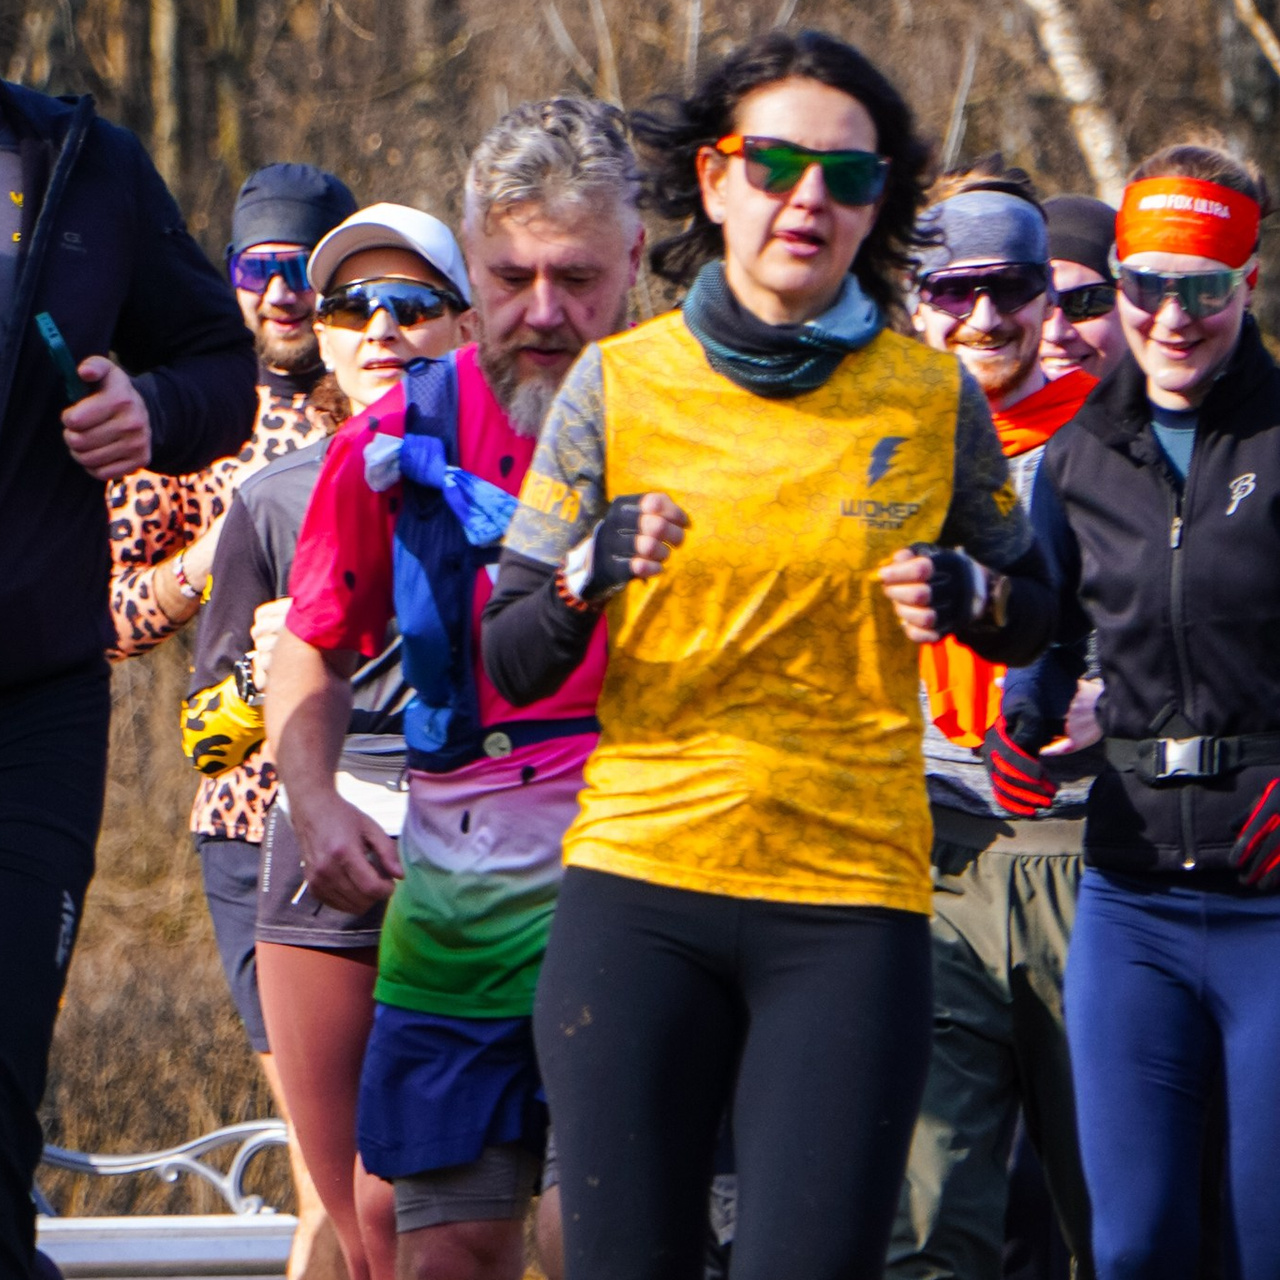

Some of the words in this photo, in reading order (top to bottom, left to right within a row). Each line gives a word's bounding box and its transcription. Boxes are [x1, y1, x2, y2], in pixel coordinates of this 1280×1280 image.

[1167, 194, 1194, 211] FOX
[1194, 198, 1231, 219] ULTRA
[840, 499, 920, 519] ШОКЕР
